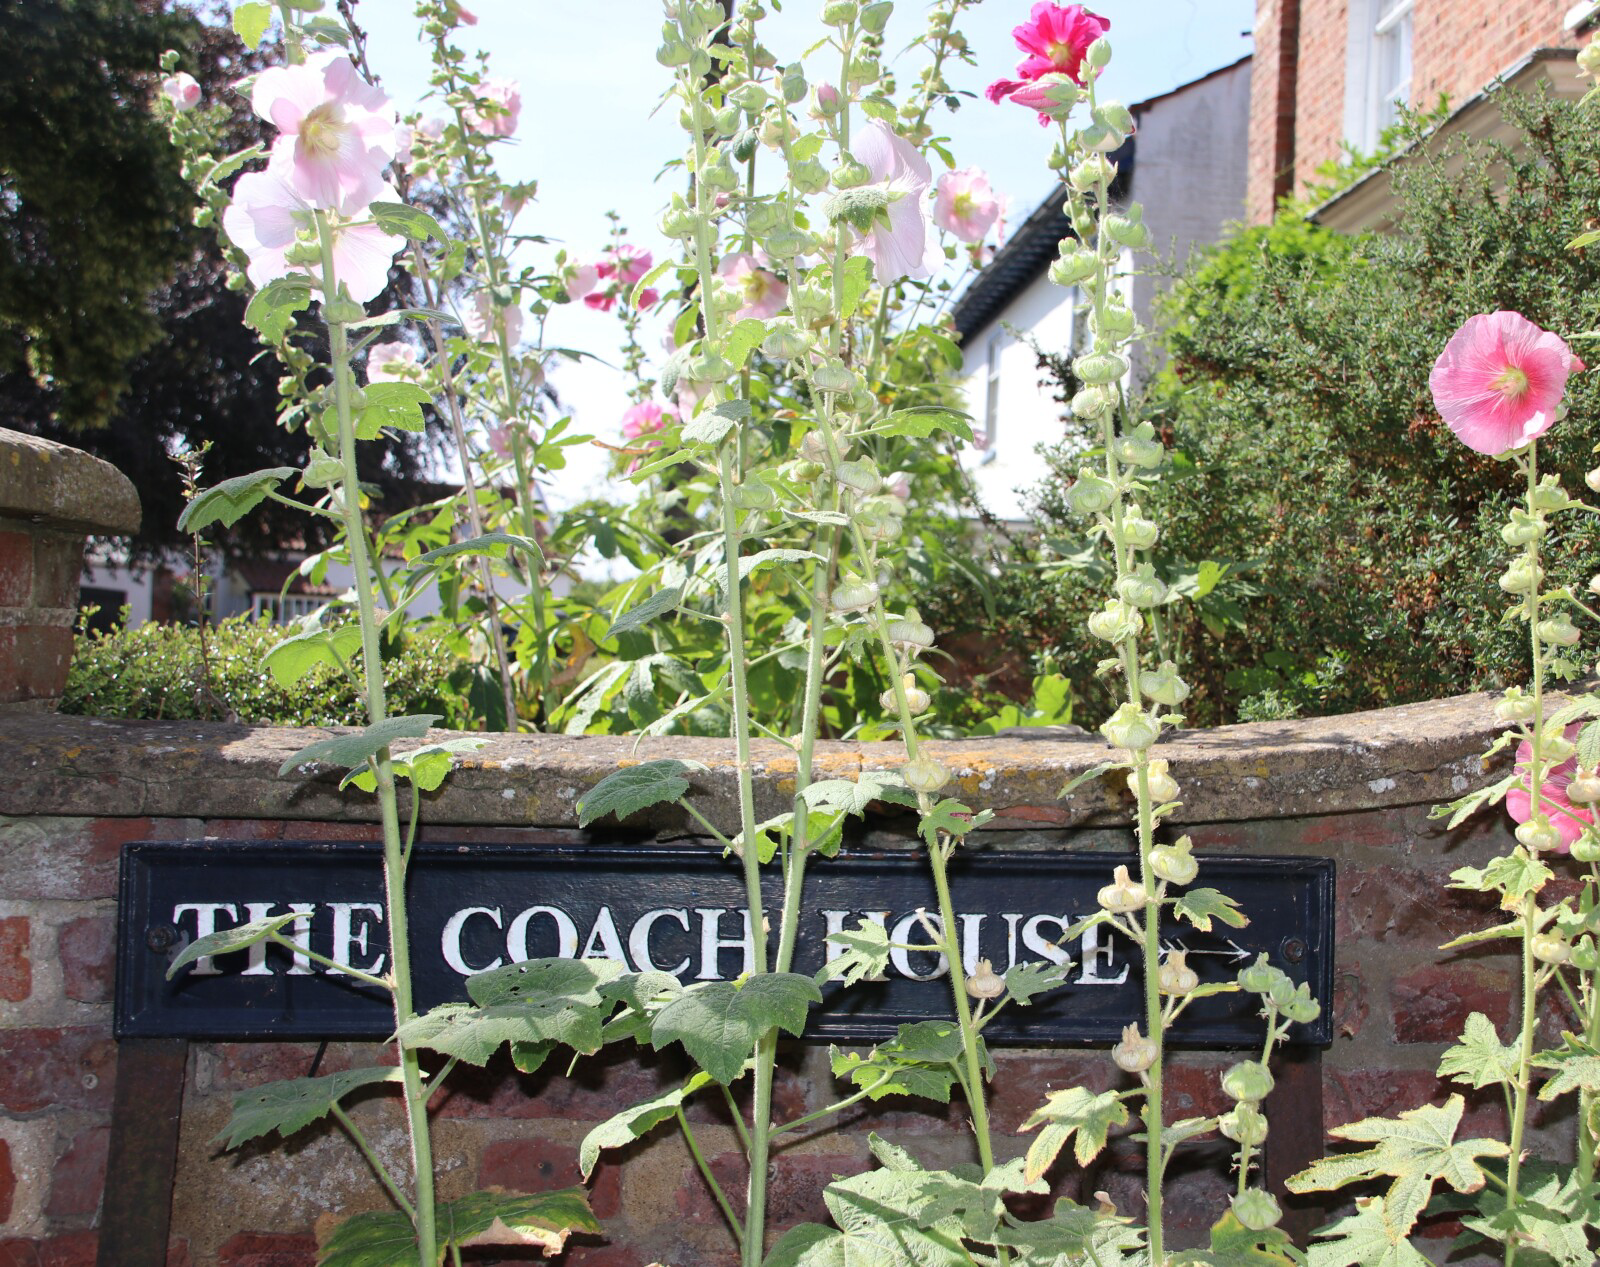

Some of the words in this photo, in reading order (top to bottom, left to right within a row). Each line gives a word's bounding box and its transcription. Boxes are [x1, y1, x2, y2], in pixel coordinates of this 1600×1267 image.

[173, 902, 385, 976] THE
[441, 905, 768, 980] COACH
[822, 910, 1129, 985] HOUSE
